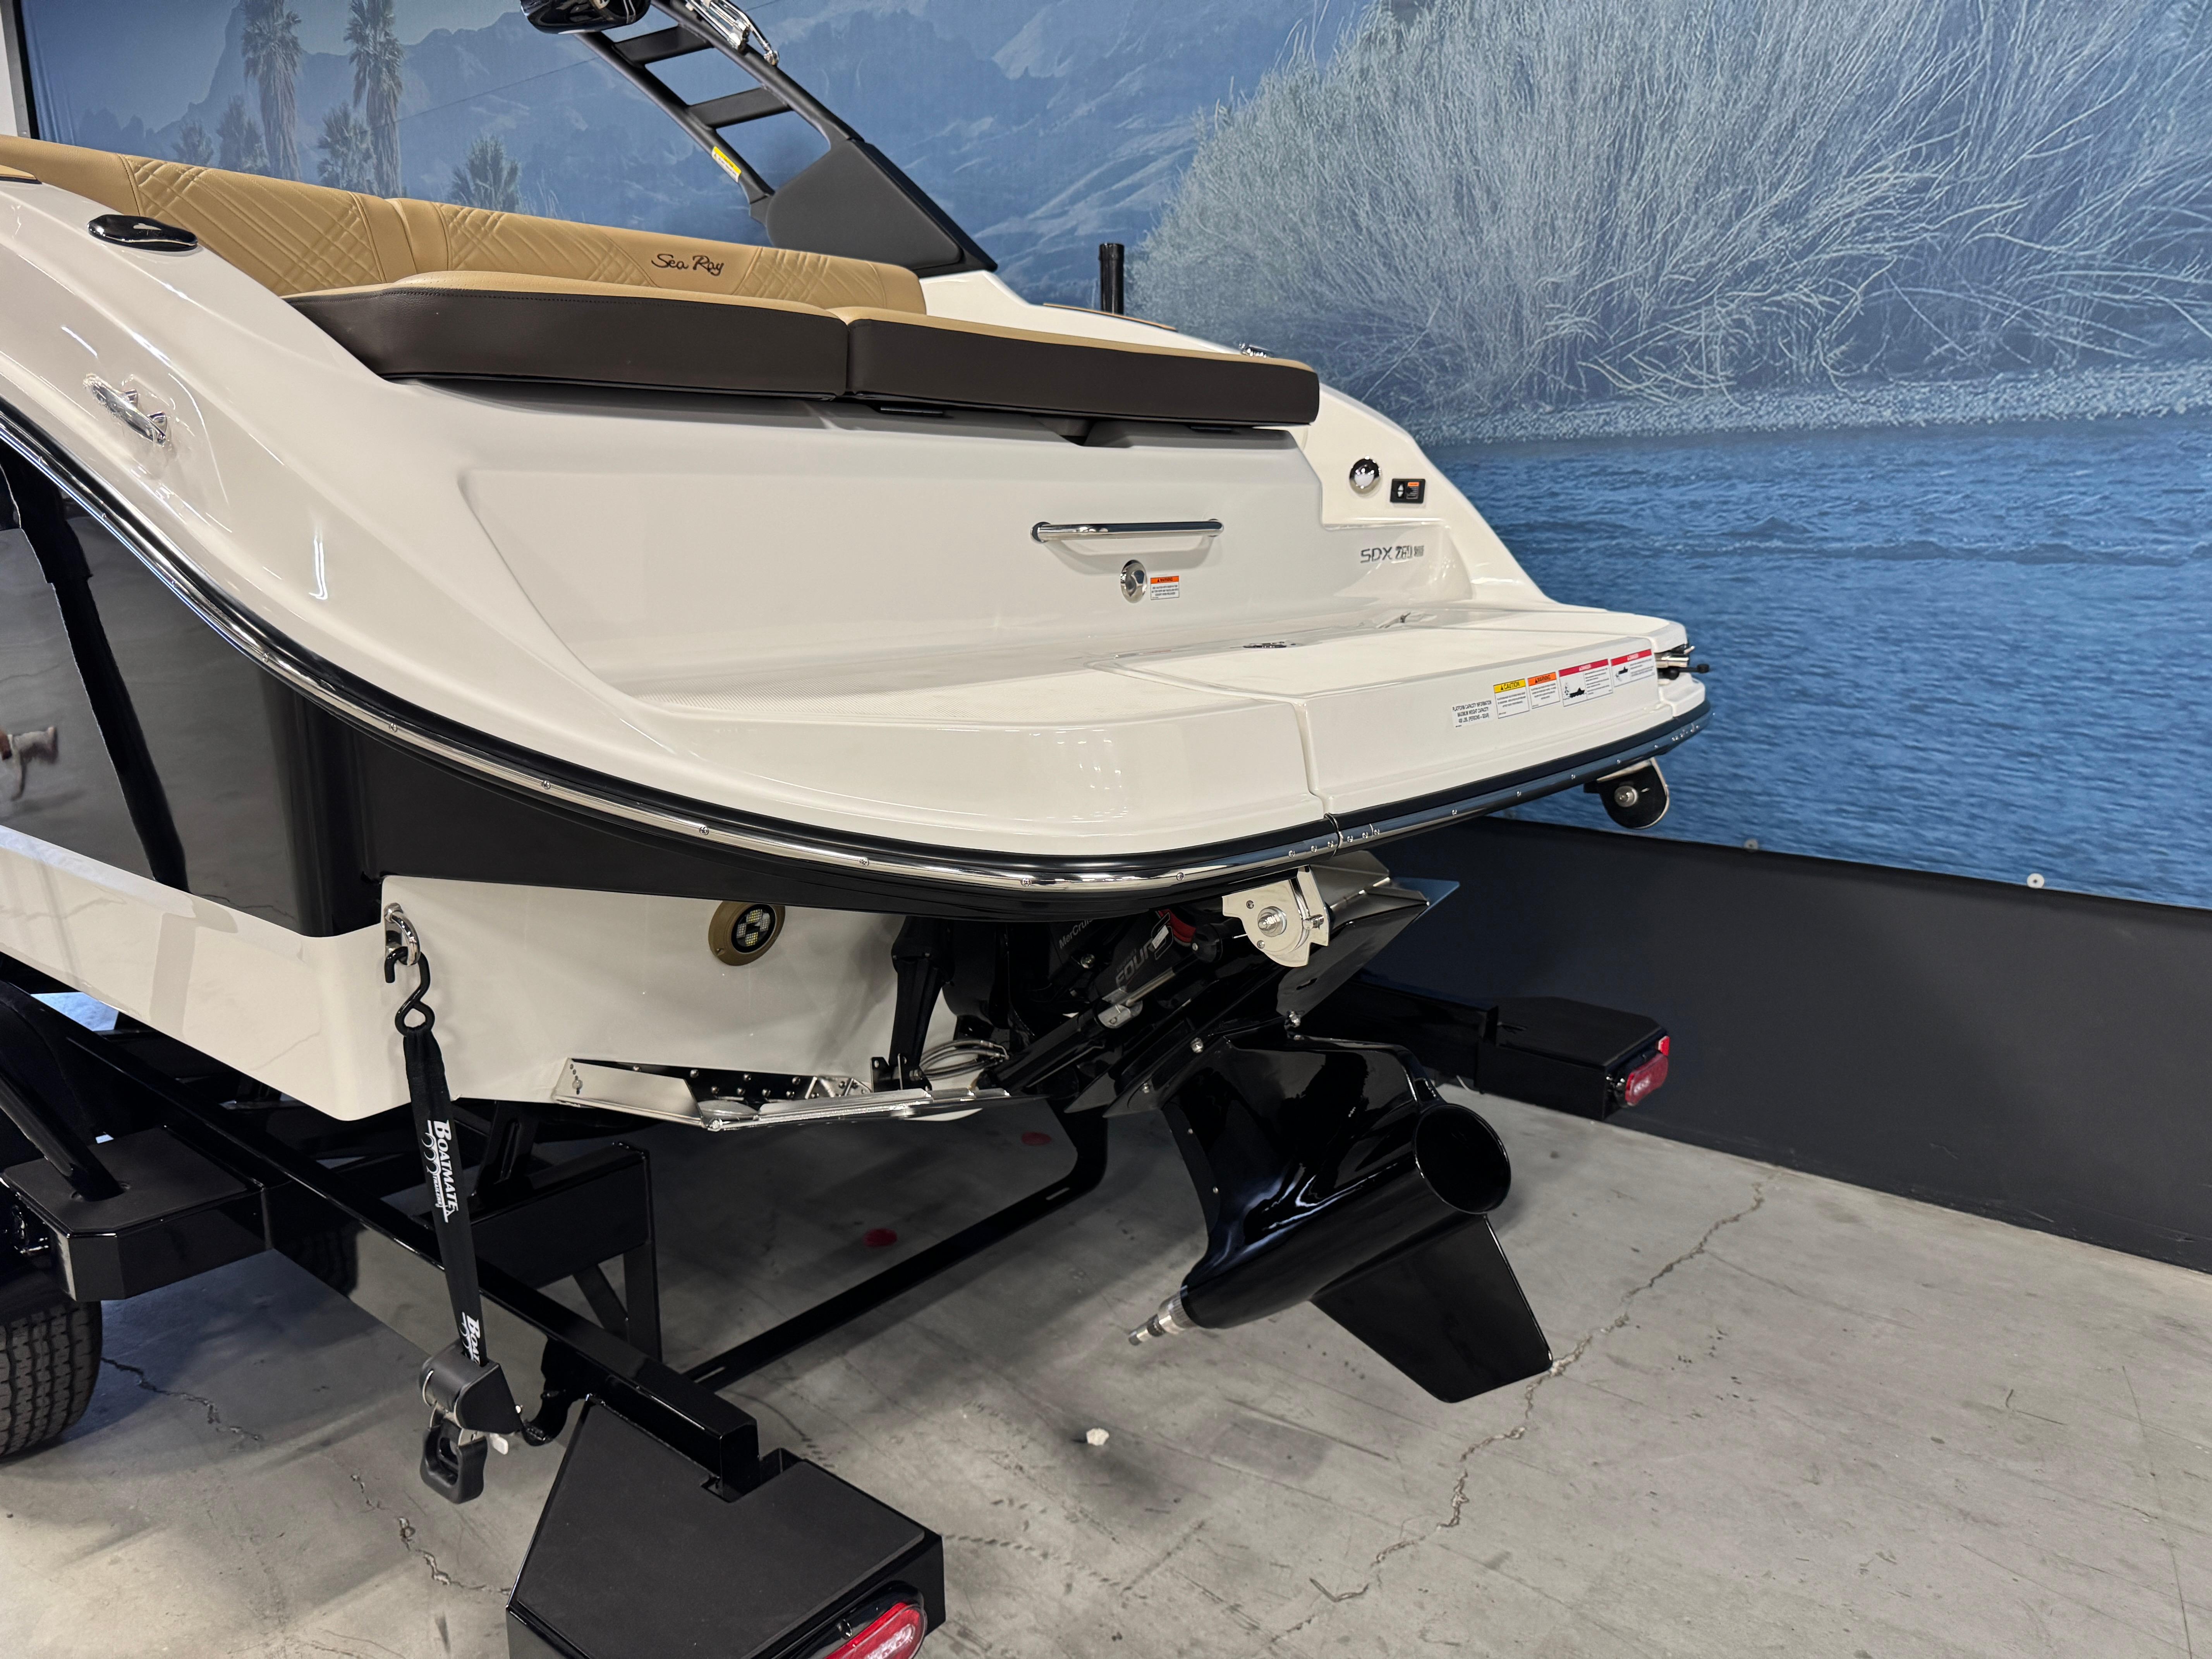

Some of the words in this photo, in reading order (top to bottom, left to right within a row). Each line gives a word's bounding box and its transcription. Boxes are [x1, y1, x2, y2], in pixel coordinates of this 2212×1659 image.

[651, 253, 689, 270] Sea
[692, 255, 725, 276] Ray
[1360, 546, 1393, 563] SDX
[1503, 681, 1520, 690] CAUTION
[433, 1119, 459, 1211] BOATMATE
[466, 1315, 481, 1365] BOAT
